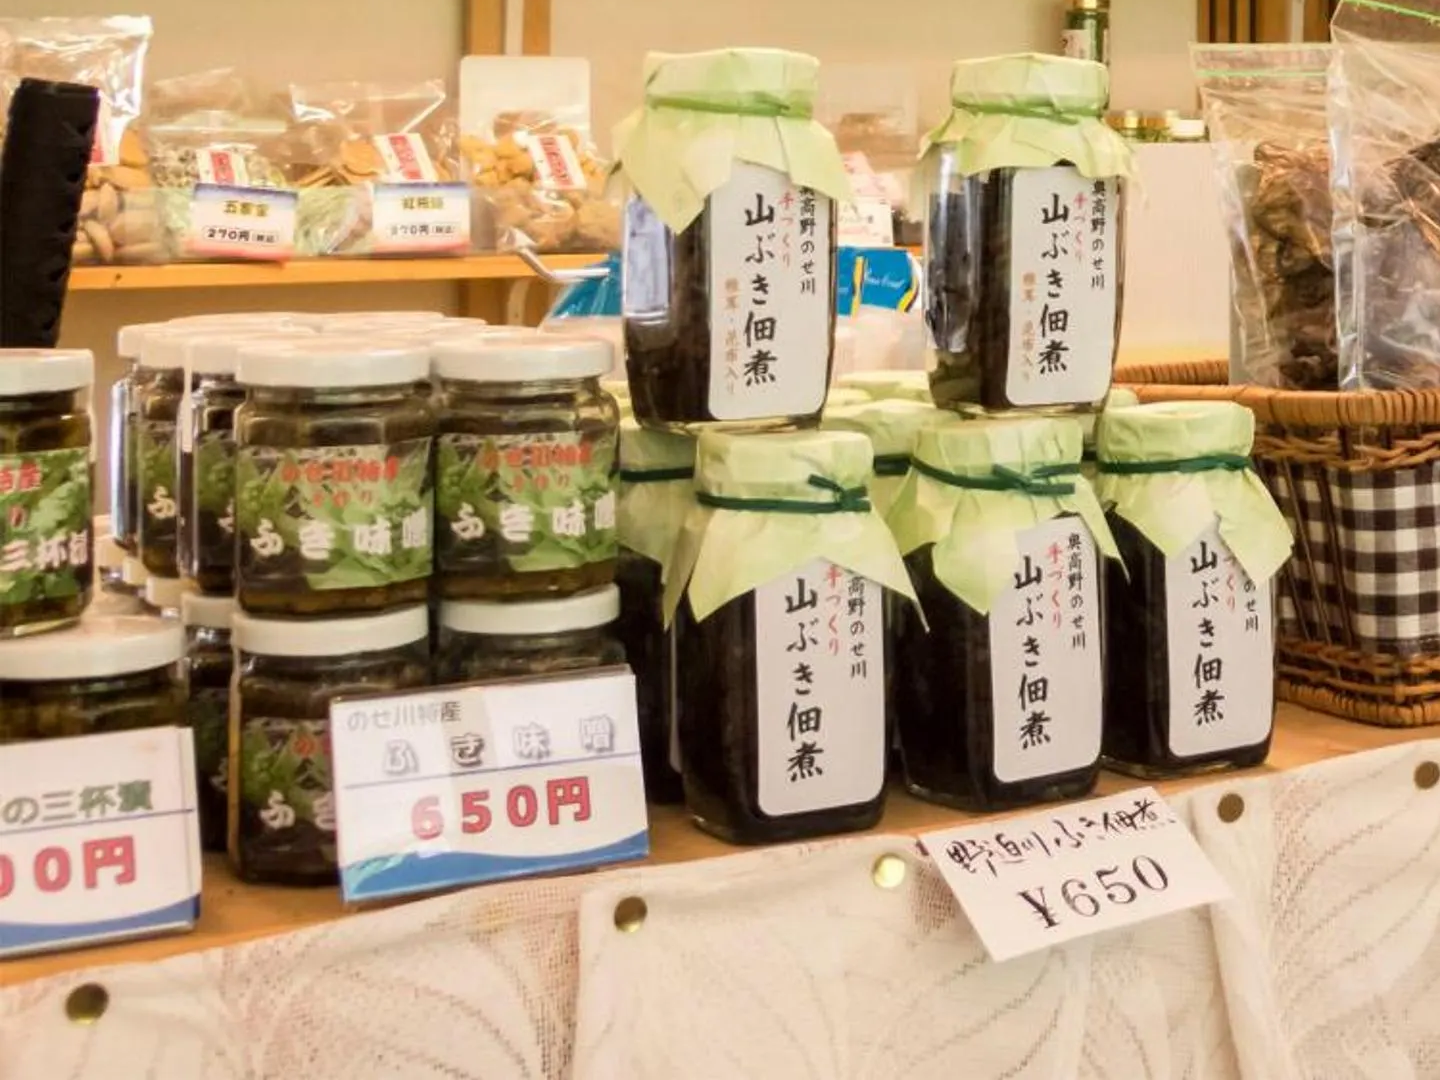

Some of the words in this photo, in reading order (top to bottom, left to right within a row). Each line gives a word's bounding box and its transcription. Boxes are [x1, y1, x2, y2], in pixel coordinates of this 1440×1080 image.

[743, 192, 778, 387] 山ぶき佃煮
[1038, 192, 1071, 376] 山ぶき佃煮
[823, 564, 844, 657] 手づくり
[846, 569, 868, 680] 高野のせ川
[1047, 542, 1063, 630] 手づくり
[1066, 531, 1087, 651] 奥高野のせ川
[1190, 540, 1226, 727] 山ぶき佃煮
[783, 577, 825, 784] 山ぶき佃煮
[1013, 554, 1052, 750] 山ぶき佃煮
[347, 701, 462, 731] のせ川特産
[384, 713, 616, 775] ふき味噌
[411, 776, 592, 840] 650円
[1018, 854, 1169, 930] ¥650
